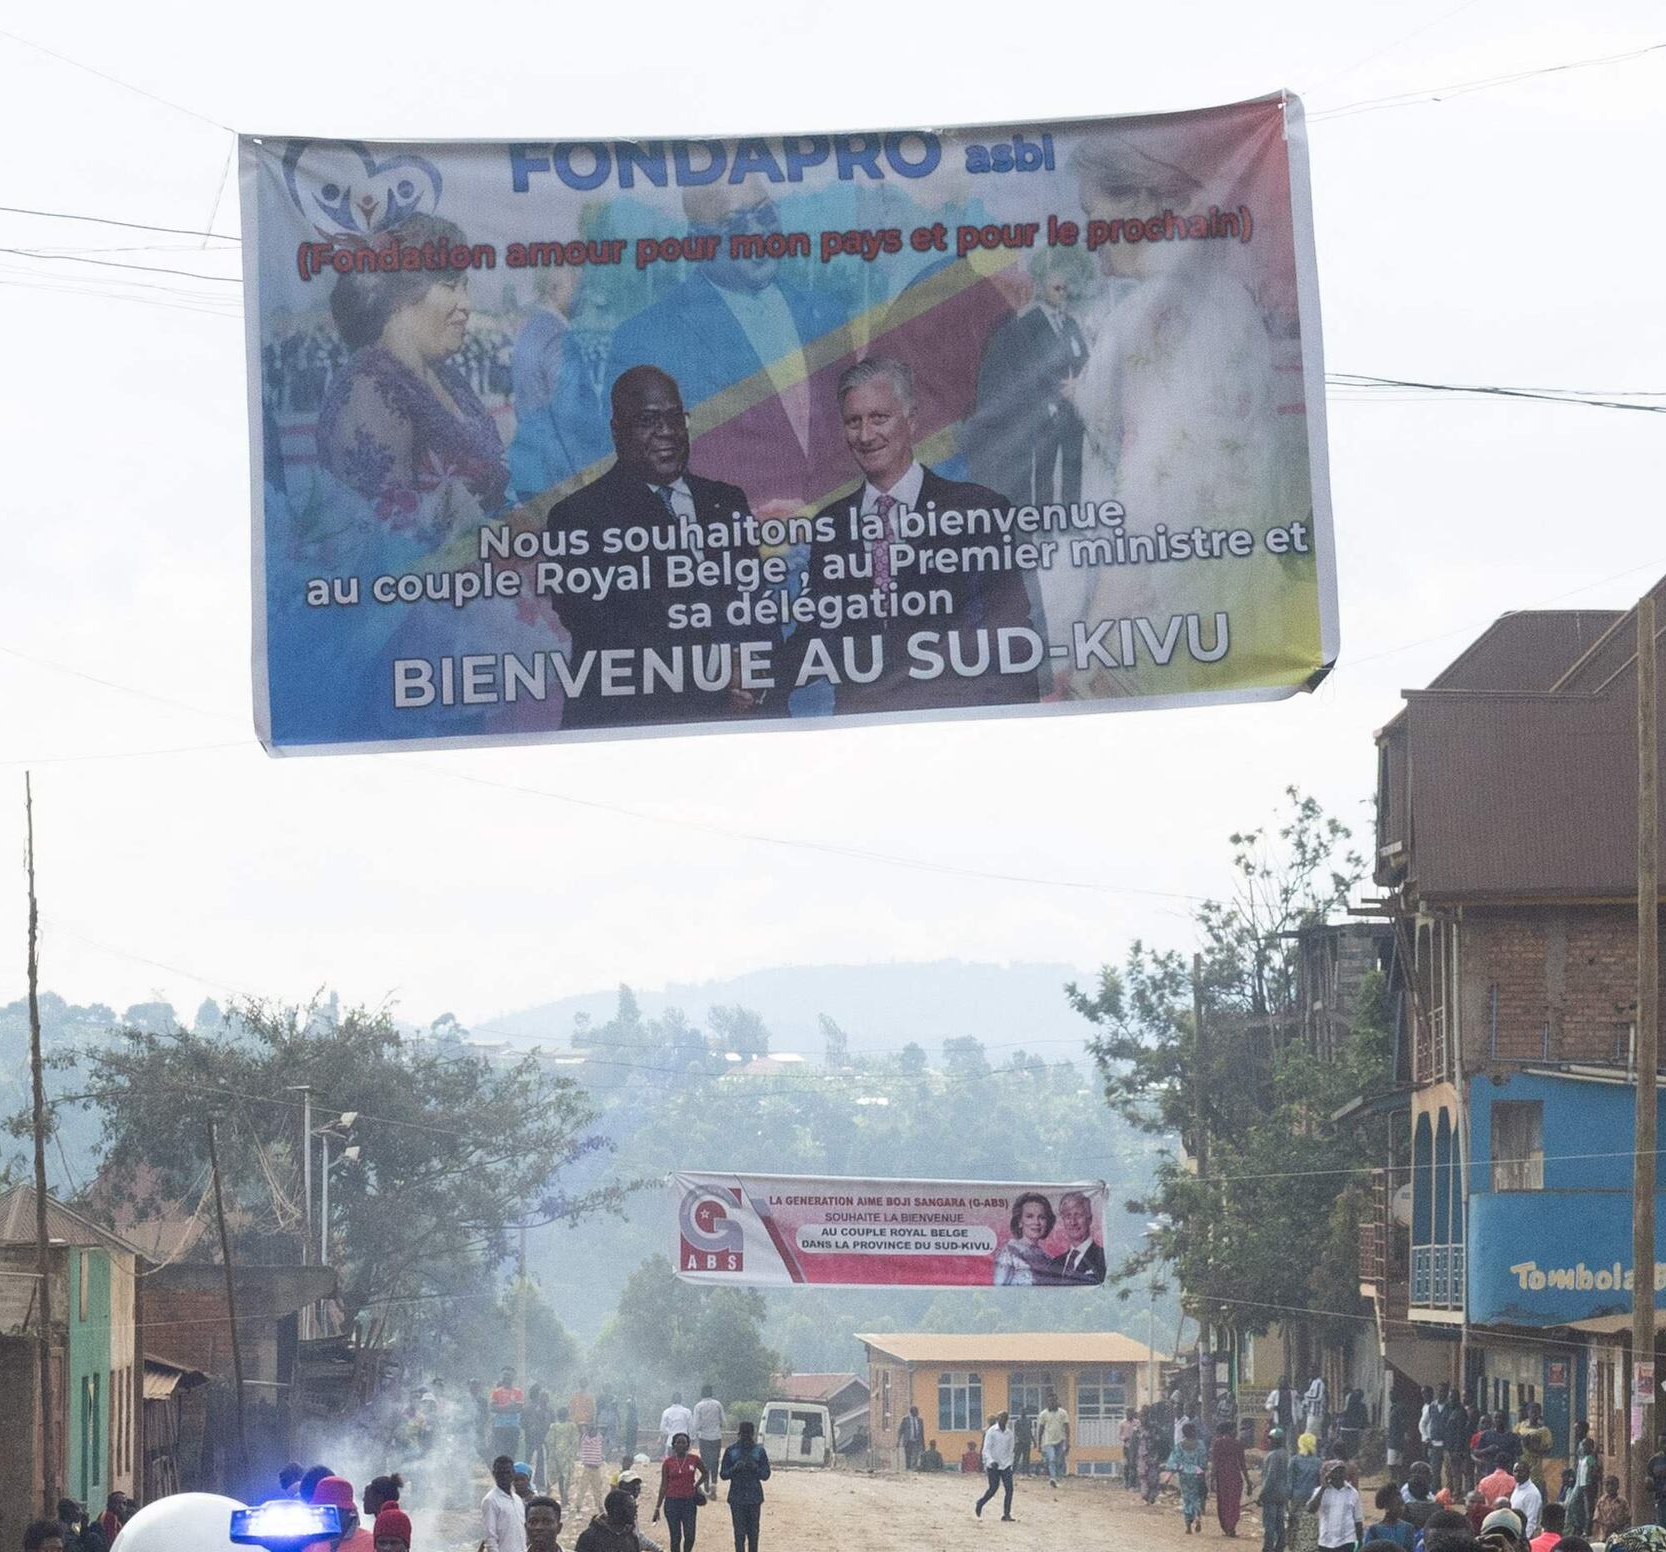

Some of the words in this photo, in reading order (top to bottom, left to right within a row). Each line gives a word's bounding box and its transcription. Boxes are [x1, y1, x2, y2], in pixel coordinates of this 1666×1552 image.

[510, 132, 942, 193] FONDAPRO
[965, 134, 1055, 174] asbl
[297, 236, 496, 281] (Fondation
[506, 236, 626, 268] amour
[636, 232, 720, 270] pour
[729, 231, 810, 262] mon
[820, 226, 903, 261] pays
[910, 221, 947, 252] et
[957, 220, 1039, 257] pour
[1047, 215, 1079, 247] le
[1087, 206, 1253, 250] prochain)
[480, 525, 590, 560] Nous
[603, 512, 836, 555] souhaitons
[849, 507, 885, 540] la
[898, 500, 1124, 538] bienvenue
[307, 576, 359, 606] au
[373, 562, 521, 607] couple
[536, 557, 651, 601] Royal
[666, 551, 786, 593] Belge
[822, 550, 872, 580] au
[888, 535, 1058, 576] Premier
[1072, 523, 1253, 567] ministre
[1265, 521, 1309, 554] et
[667, 600, 712, 630] sa
[727, 583, 954, 630] délégation
[393, 641, 775, 709] BIENVENUE
[795, 633, 884, 688] AU
[908, 612, 1230, 681] SUD-KIVU
[769, 1196, 782, 1205] LA
[786, 1196, 853, 1206] GENERATION
[857, 1197, 883, 1206] AIME
[886, 1197, 911, 1207] BOJI
[914, 1198, 965, 1207] SANGARA
[825, 1213, 881, 1222] SOUHAITE
[884, 1213, 898, 1222] LA
[901, 1213, 965, 1222] BIENVENUE
[802, 1240, 832, 1249] DANS
[835, 1240, 850, 1249] LA
[852, 1240, 911, 1250] PROVINCE
[915, 1241, 931, 1250] DU
[934, 1241, 993, 1251] SUD-KIVU.
[821, 1228, 837, 1236] AU
[841, 1228, 887, 1237] COUPLE
[890, 1228, 927, 1237] ROYAL
[931, 1229, 968, 1237] BELGE
